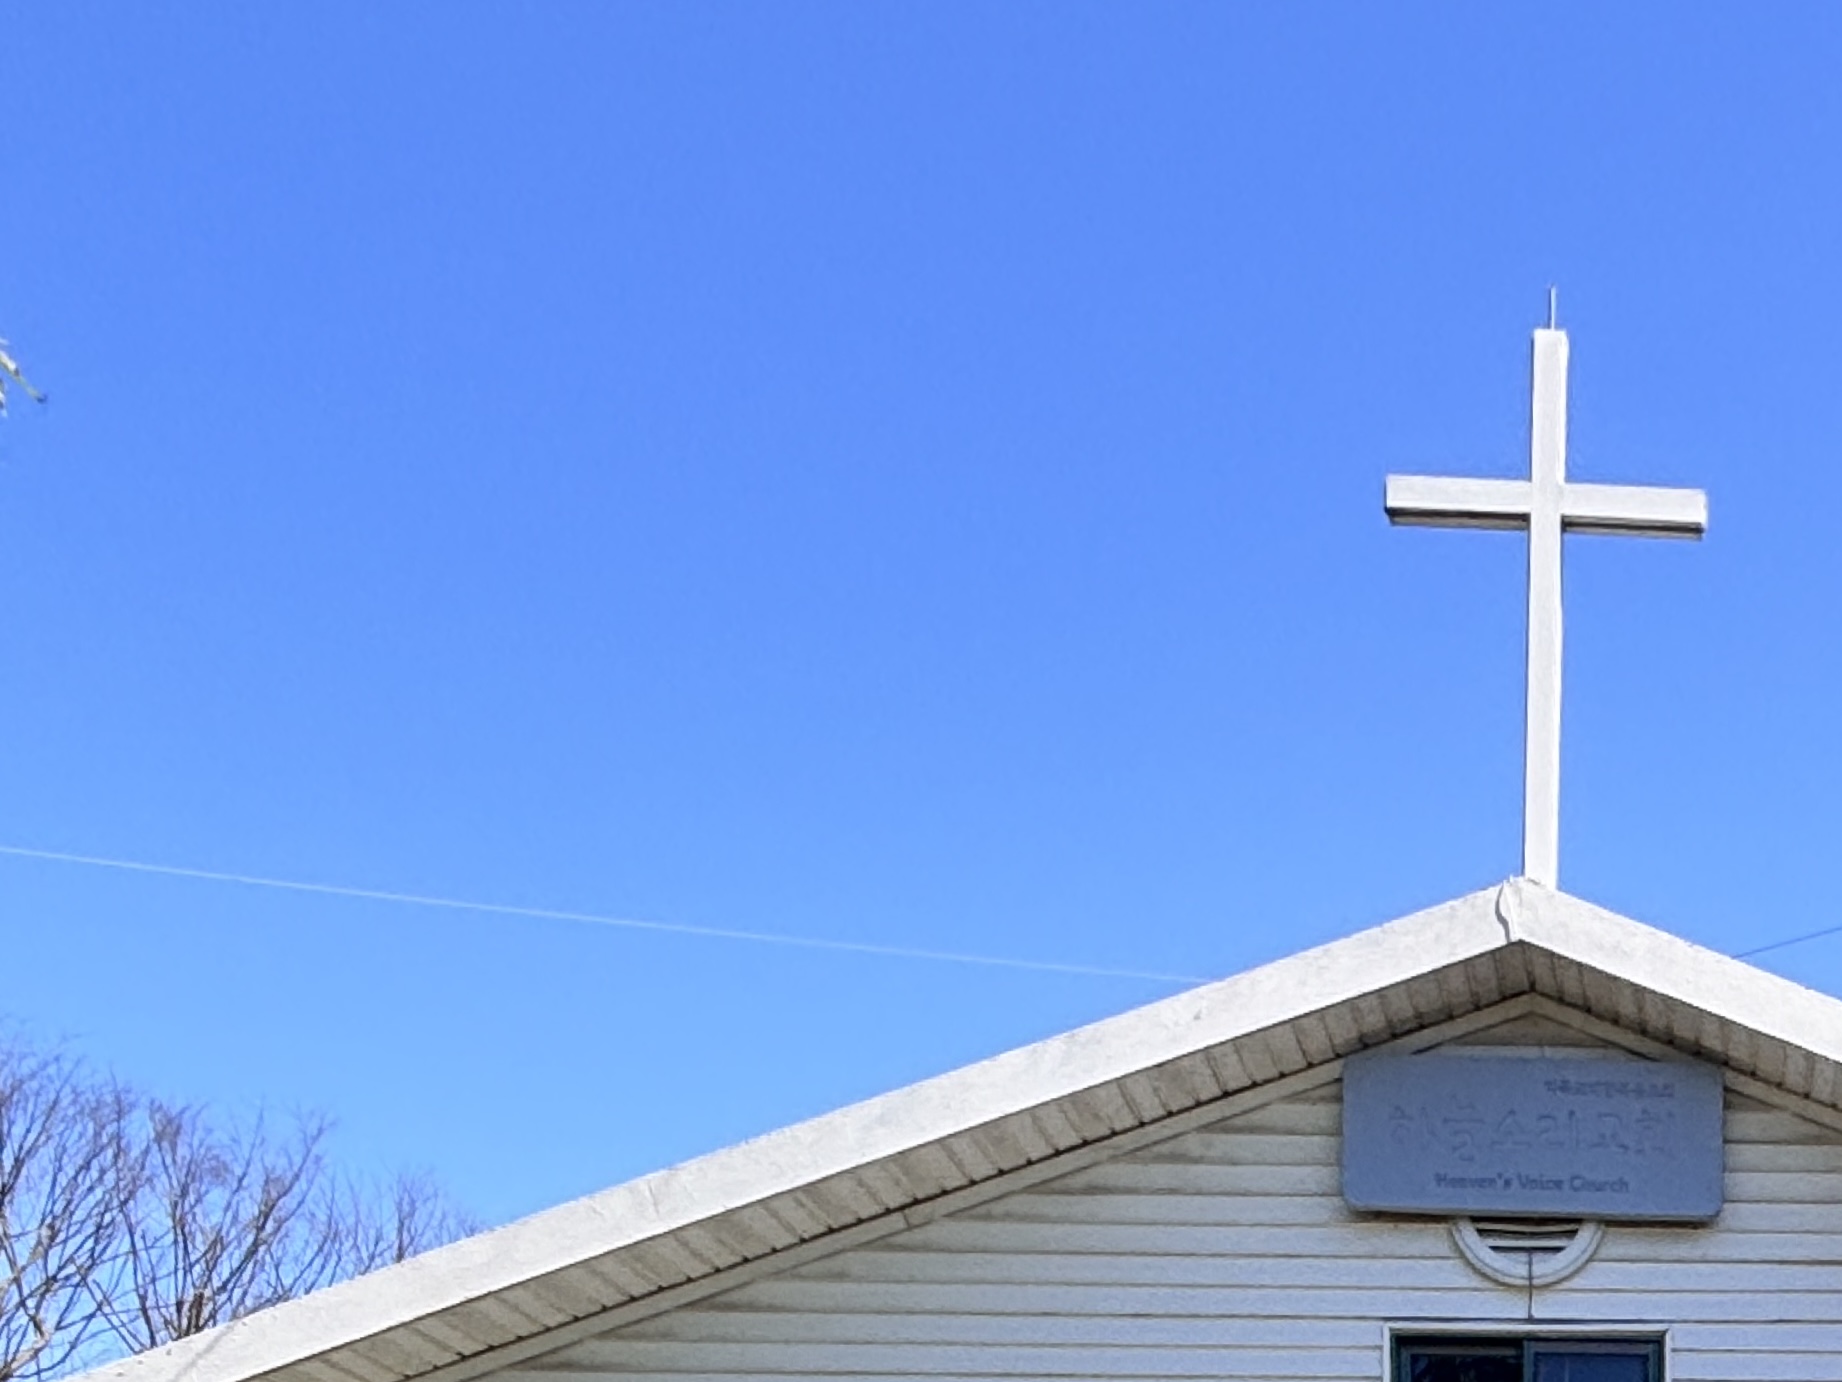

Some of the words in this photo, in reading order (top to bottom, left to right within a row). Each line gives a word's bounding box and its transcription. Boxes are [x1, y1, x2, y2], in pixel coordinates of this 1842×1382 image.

[1435, 1172, 1512, 1191] Heaven's
[1517, 1172, 1565, 1191] Voice
[1570, 1173, 1629, 1192] Church
